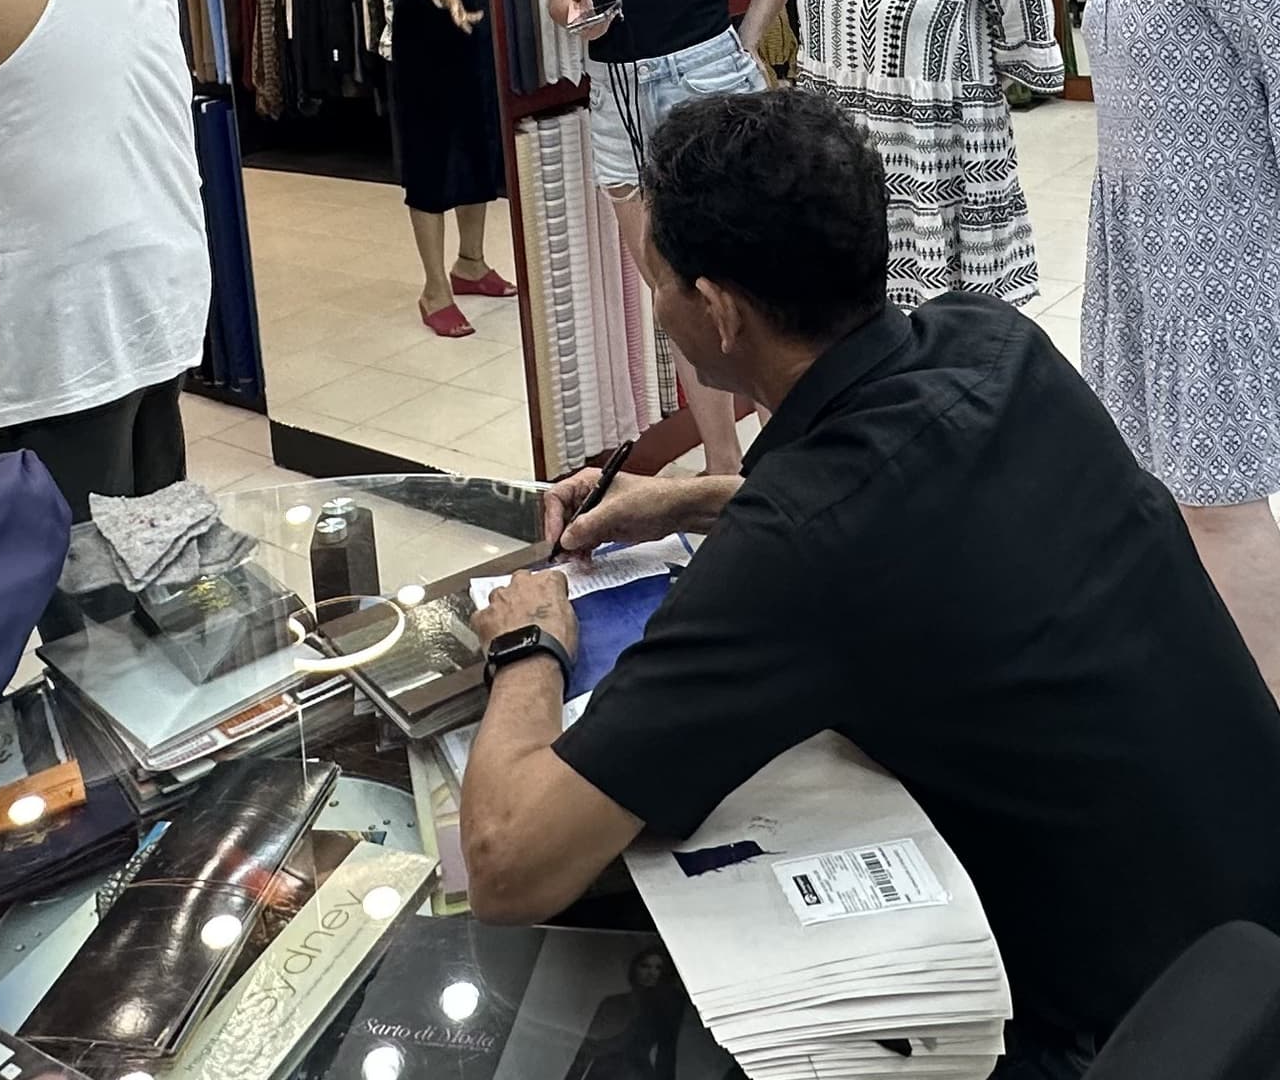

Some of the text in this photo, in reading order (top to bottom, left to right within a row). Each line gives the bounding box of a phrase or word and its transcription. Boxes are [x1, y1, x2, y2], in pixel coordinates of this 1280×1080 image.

[364, 1017, 411, 1039] Sarto
[413, 1025, 437, 1041] di
[439, 1026, 495, 1048] Moda
